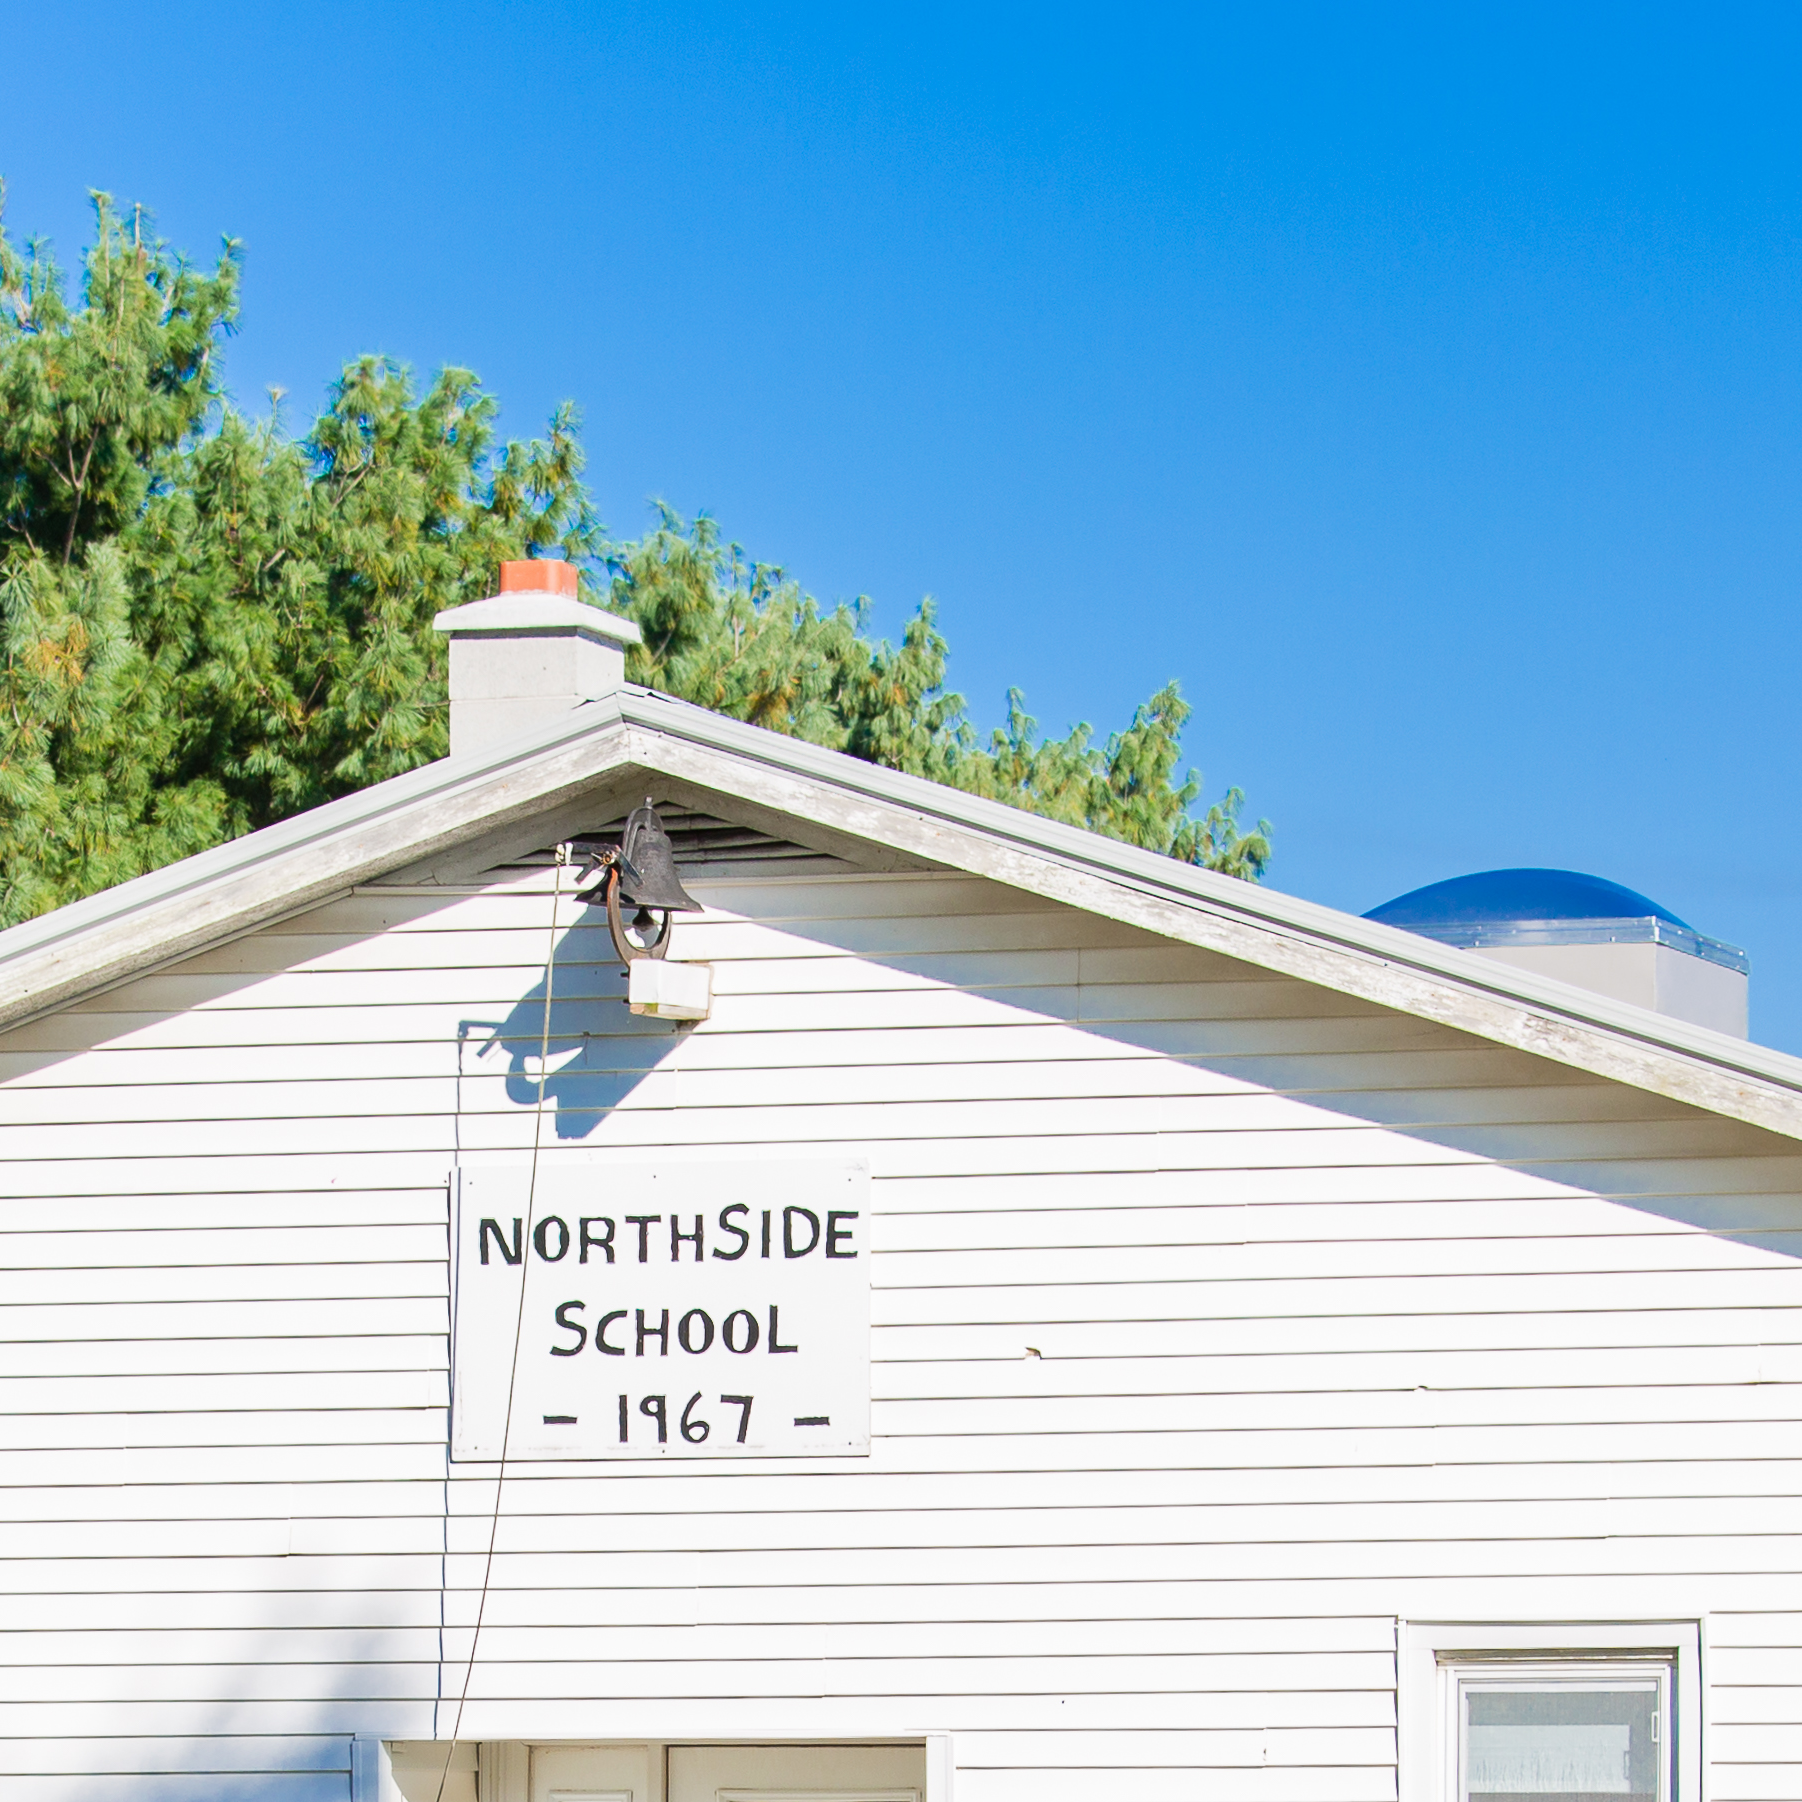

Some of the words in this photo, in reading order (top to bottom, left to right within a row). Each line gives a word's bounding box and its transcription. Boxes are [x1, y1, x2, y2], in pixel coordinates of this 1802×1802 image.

[479, 1202, 859, 1265] NORTHSIDE
[549, 1300, 798, 1357] SCHOOL
[618, 1391, 754, 1444] 1967
